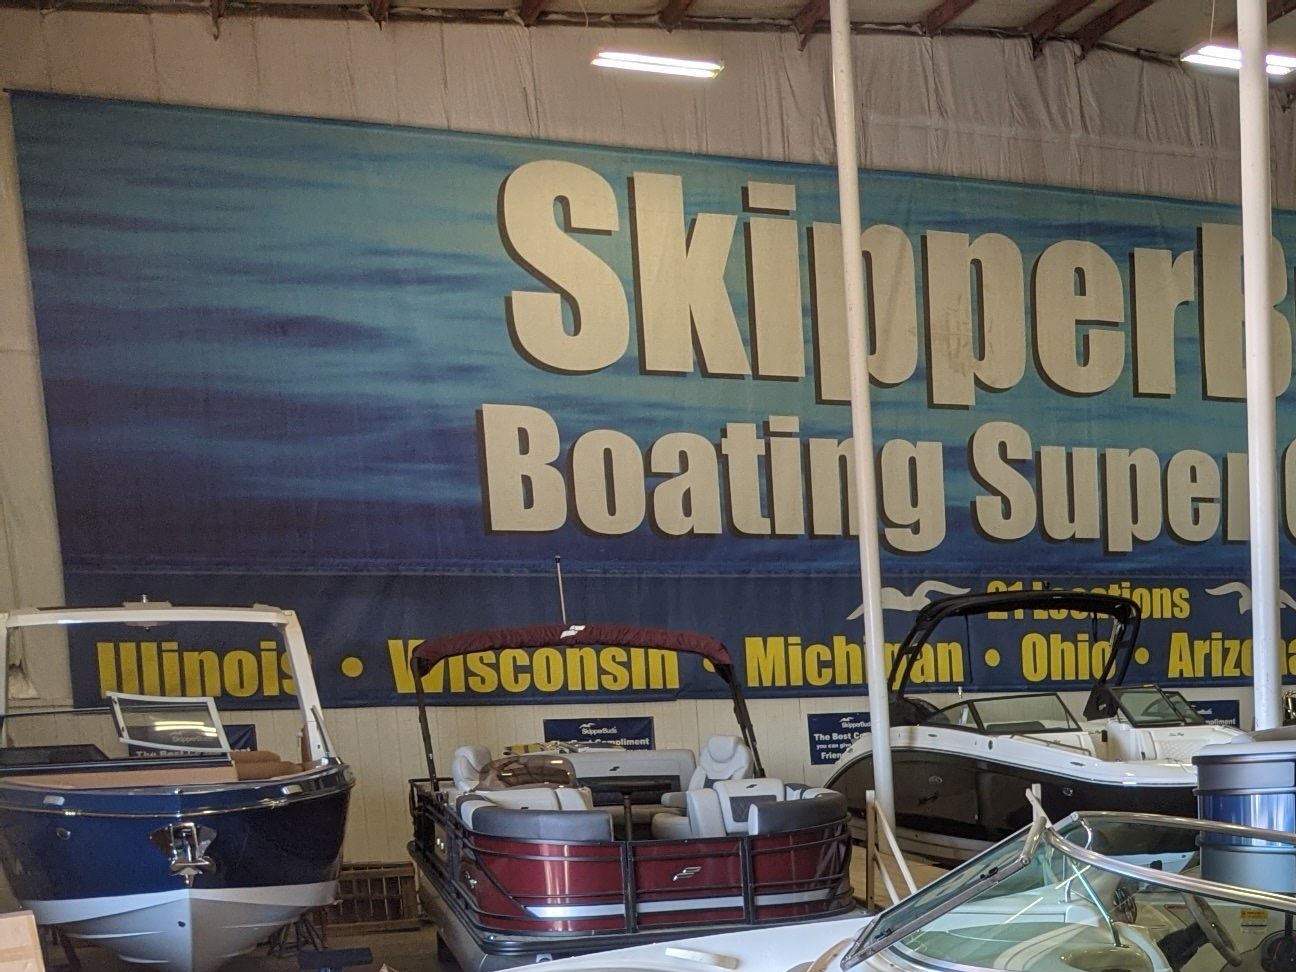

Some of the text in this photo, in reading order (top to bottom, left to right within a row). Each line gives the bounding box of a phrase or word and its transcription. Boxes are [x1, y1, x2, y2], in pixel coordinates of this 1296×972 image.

[480, 403, 947, 552] Boating
[1021, 632, 1117, 682] Ohio
[813, 733, 831, 741] The
